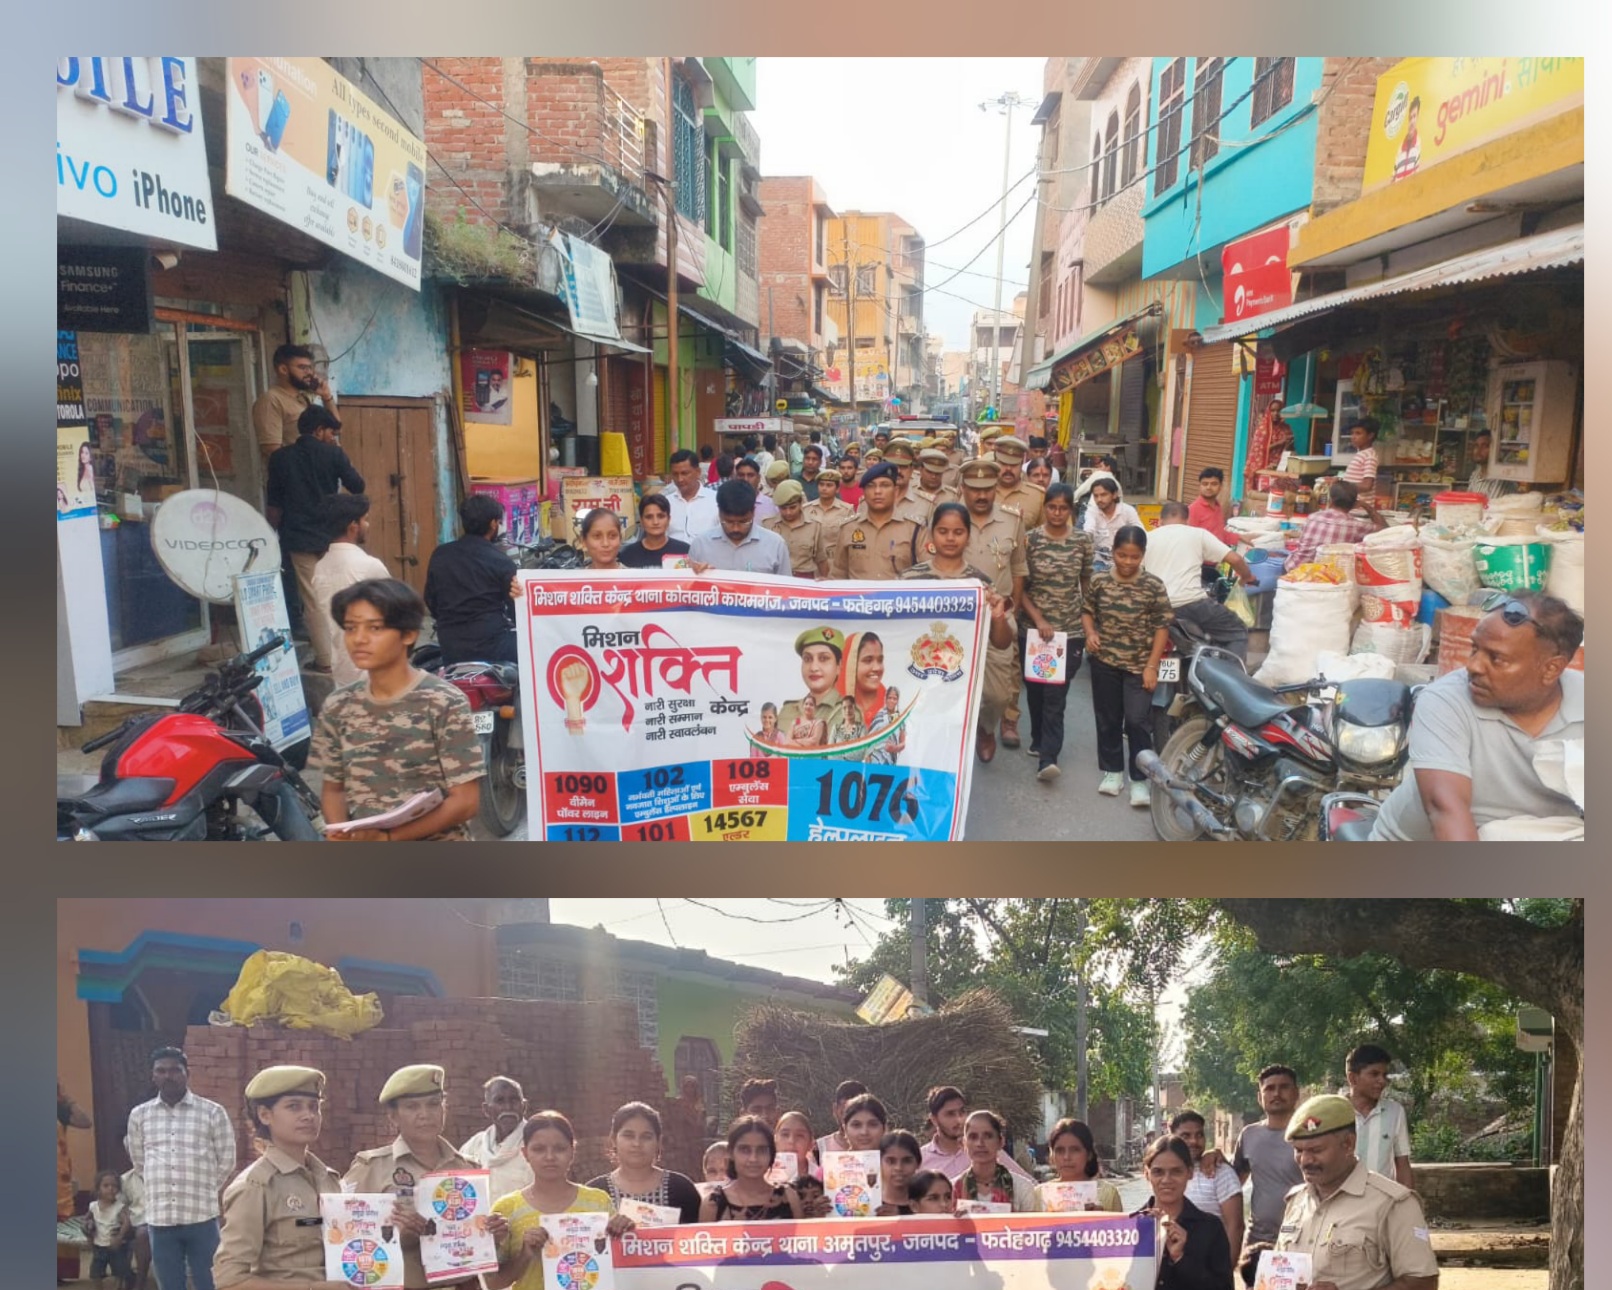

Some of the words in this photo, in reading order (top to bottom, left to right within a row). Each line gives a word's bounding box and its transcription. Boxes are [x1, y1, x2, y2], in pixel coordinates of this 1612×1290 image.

[1434, 58, 1507, 147] gemini
[332, 77, 346, 101] All
[350, 92, 371, 120] types
[372, 114, 399, 143] second
[400, 139, 424, 162] mobile
[57, 142, 117, 198] ivo
[132, 169, 206, 225] iPhone
[59, 265, 119, 278] SAMSUNG
[100, 305, 120, 315] Here
[1260, 381, 1280, 390] ATM
[534, 585, 567, 606] मिशन
[569, 586, 603, 606] शक्ति
[605, 587, 632, 607] केन्द्र
[634, 590, 662, 605] थाना
[665, 586, 719, 607] कोतवाली
[789, 597, 830, 612] जनपद
[843, 595, 894, 617] फतेहगढ़
[895, 596, 974, 613] 9454403325
[582, 625, 640, 648] मिशन
[600, 623, 743, 733] शक्ति
[1161, 669, 1176, 680] 75
[645, 697, 665, 711] नारी
[667, 698, 695, 713] सुरक्षा
[709, 696, 750, 717] केन्द्र
[645, 712, 665, 726] नारी
[668, 712, 703, 725] सम्मान
[645, 727, 665, 741] नारी
[669, 724, 716, 739] स्वावलंबन
[643, 766, 684, 789] 102
[728, 760, 770, 780] 108
[554, 774, 607, 794] 1090
[569, 795, 595, 807] वीमेन
[738, 792, 760, 805] सेवा
[816, 768, 919, 825] 1076
[582, 809, 608, 819] लाइन
[704, 810, 767, 833] 14567
[564, 827, 600, 841] 112
[637, 820, 675, 841] 101
[621, 1232, 673, 1256] मिशन
[678, 1232, 727, 1256] शक्ति
[732, 1233, 774, 1257] केन्द्र
[778, 1235, 818, 1254] थाना
[822, 1234, 896, 1261] अमृतपुर,
[902, 1232, 960, 1250] जनपद
[980, 1225, 1052, 1254] फतेहगढ़
[1055, 1228, 1139, 1248] 9454403320
